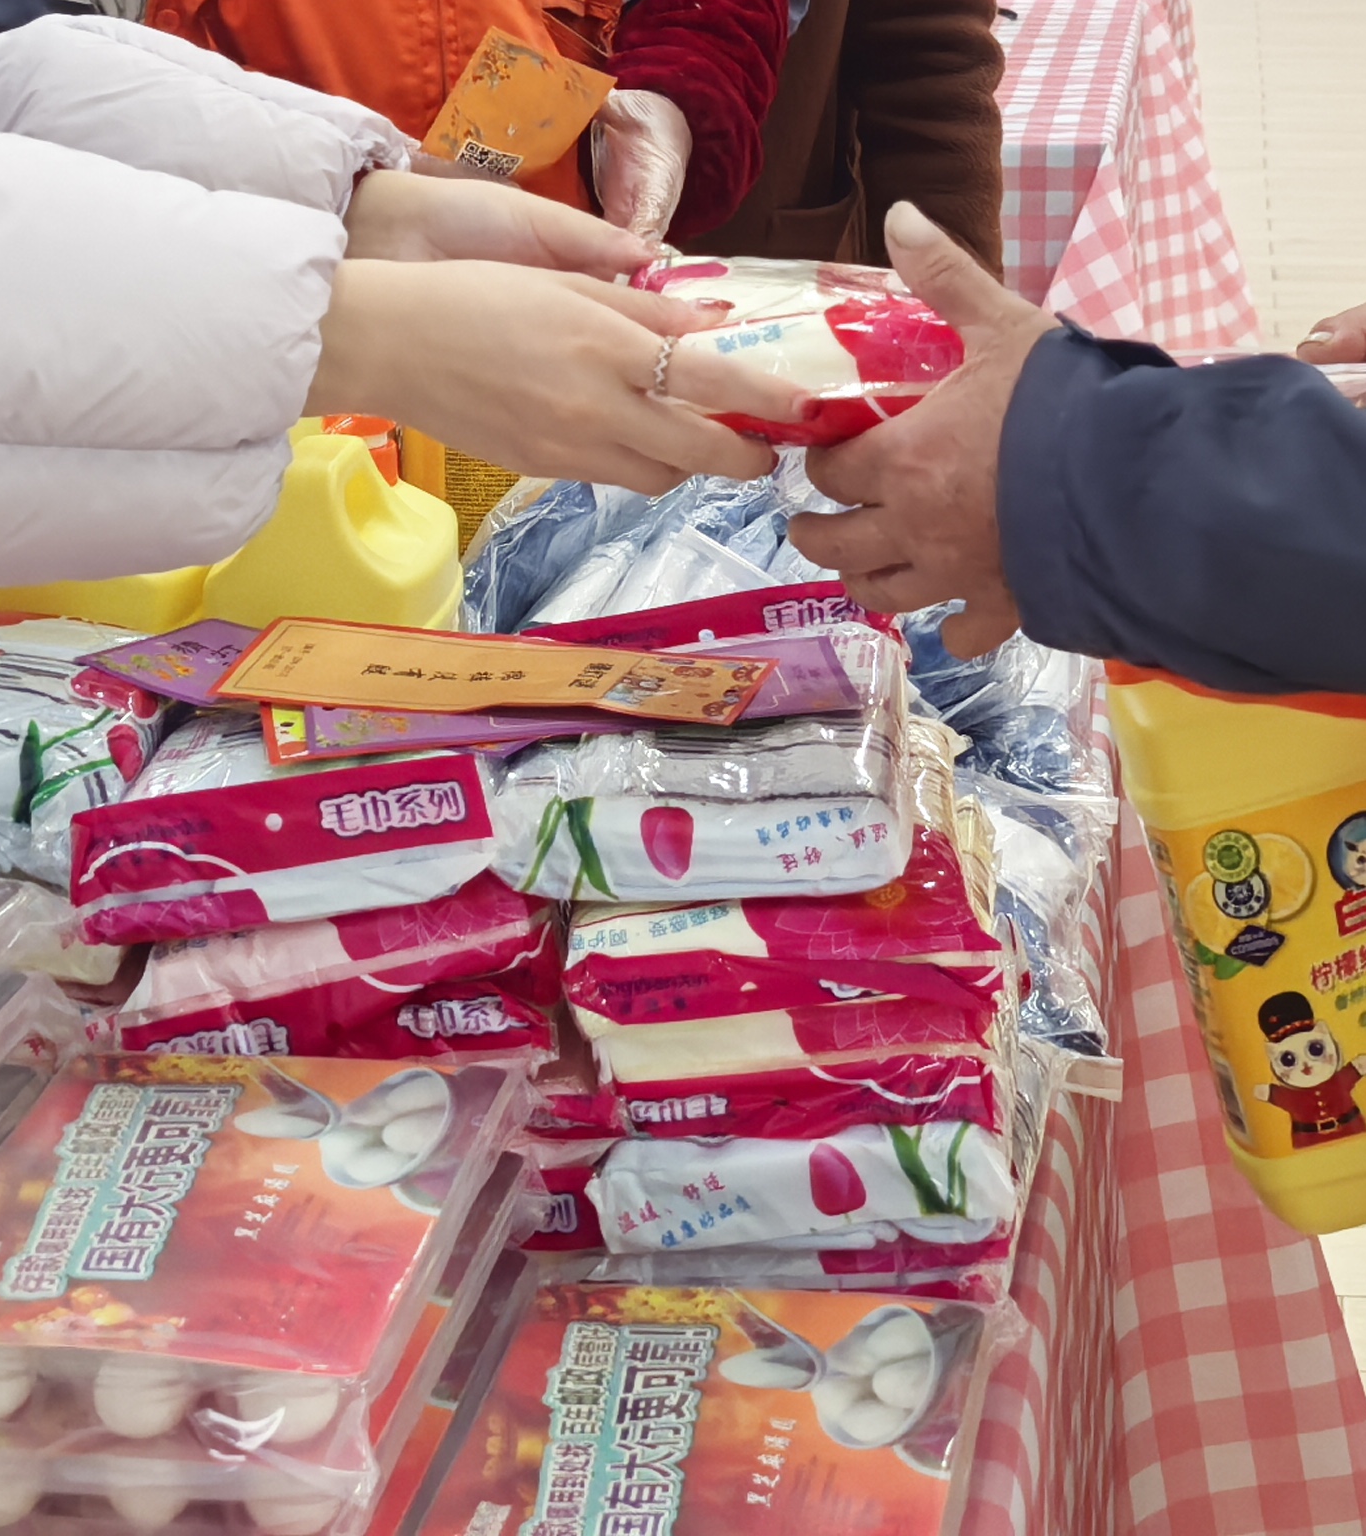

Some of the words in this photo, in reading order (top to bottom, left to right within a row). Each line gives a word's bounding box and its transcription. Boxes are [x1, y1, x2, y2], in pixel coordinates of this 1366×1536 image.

[320, 781, 467, 837] 毛巾系列
[81, 1086, 233, 1273] 国有大行更可靠!
